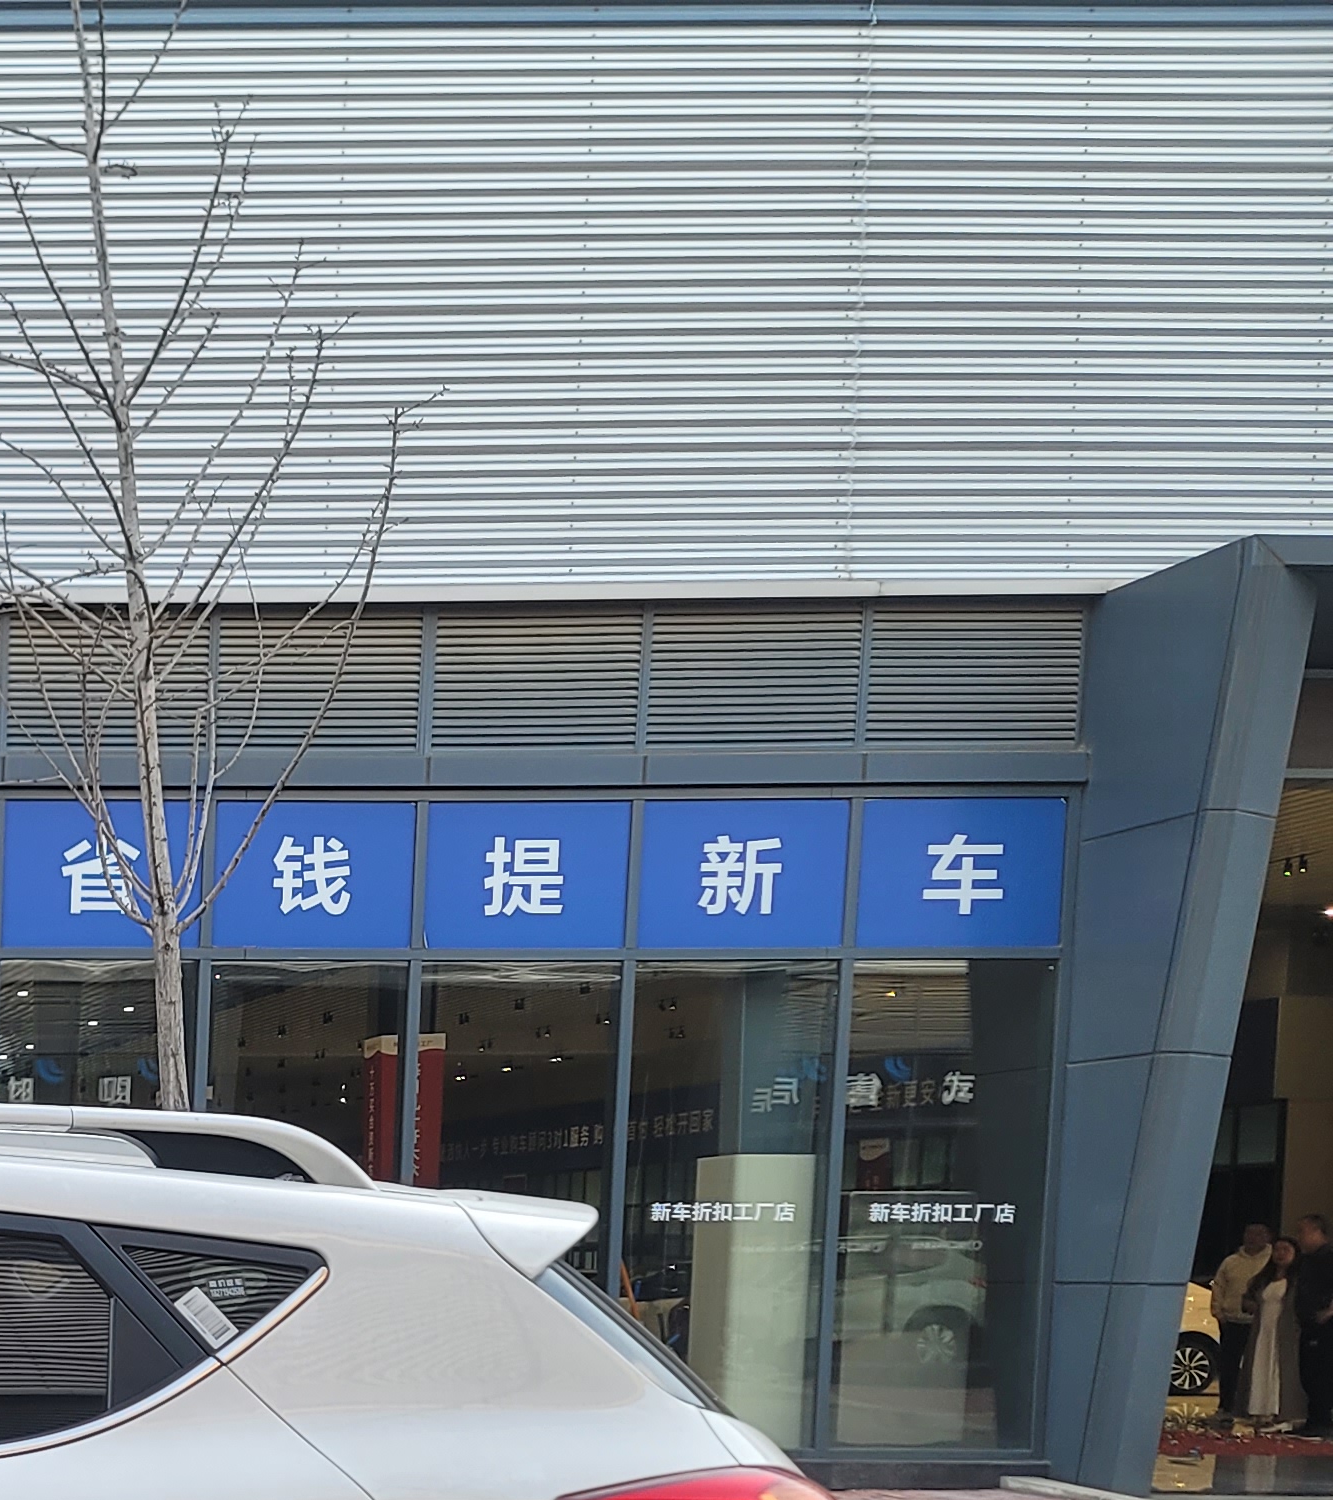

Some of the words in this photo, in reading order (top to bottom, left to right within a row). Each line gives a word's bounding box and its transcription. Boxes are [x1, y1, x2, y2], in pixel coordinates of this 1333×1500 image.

[650, 1202, 797, 1222] 新车折扣工厂店
[868, 1202, 1017, 1224] 新车折扣工厂店
